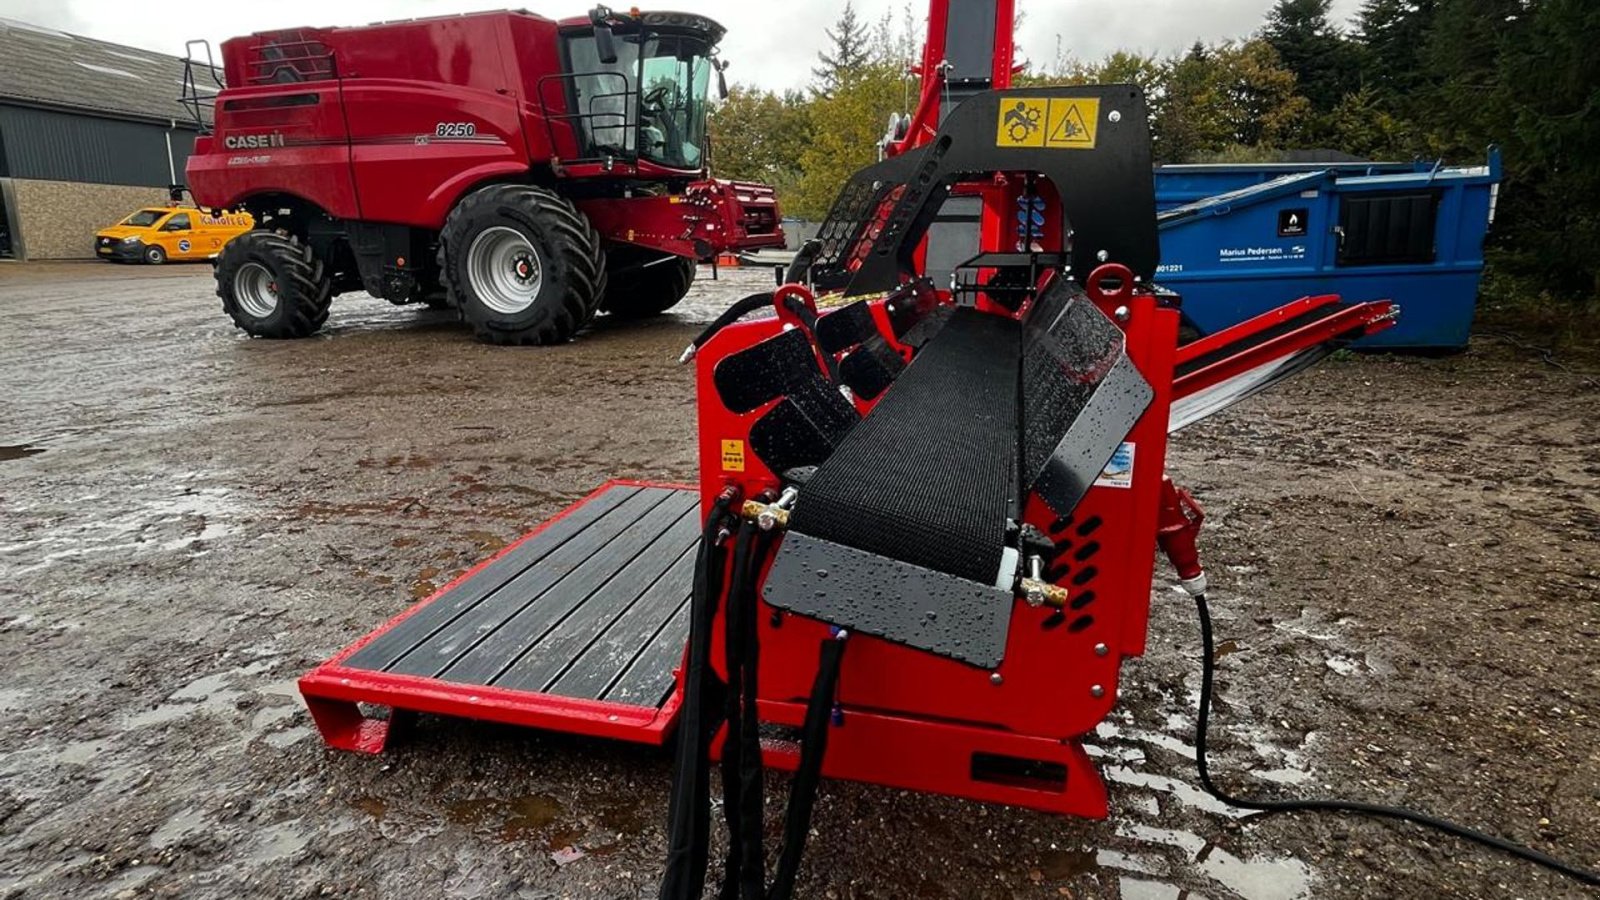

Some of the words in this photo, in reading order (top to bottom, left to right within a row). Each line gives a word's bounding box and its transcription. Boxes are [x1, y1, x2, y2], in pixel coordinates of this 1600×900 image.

[436, 122, 475, 138] 8250
[225, 135, 269, 148] CASE
[1220, 248, 1246, 256] Marius
[1247, 246, 1282, 255] Pedersen
